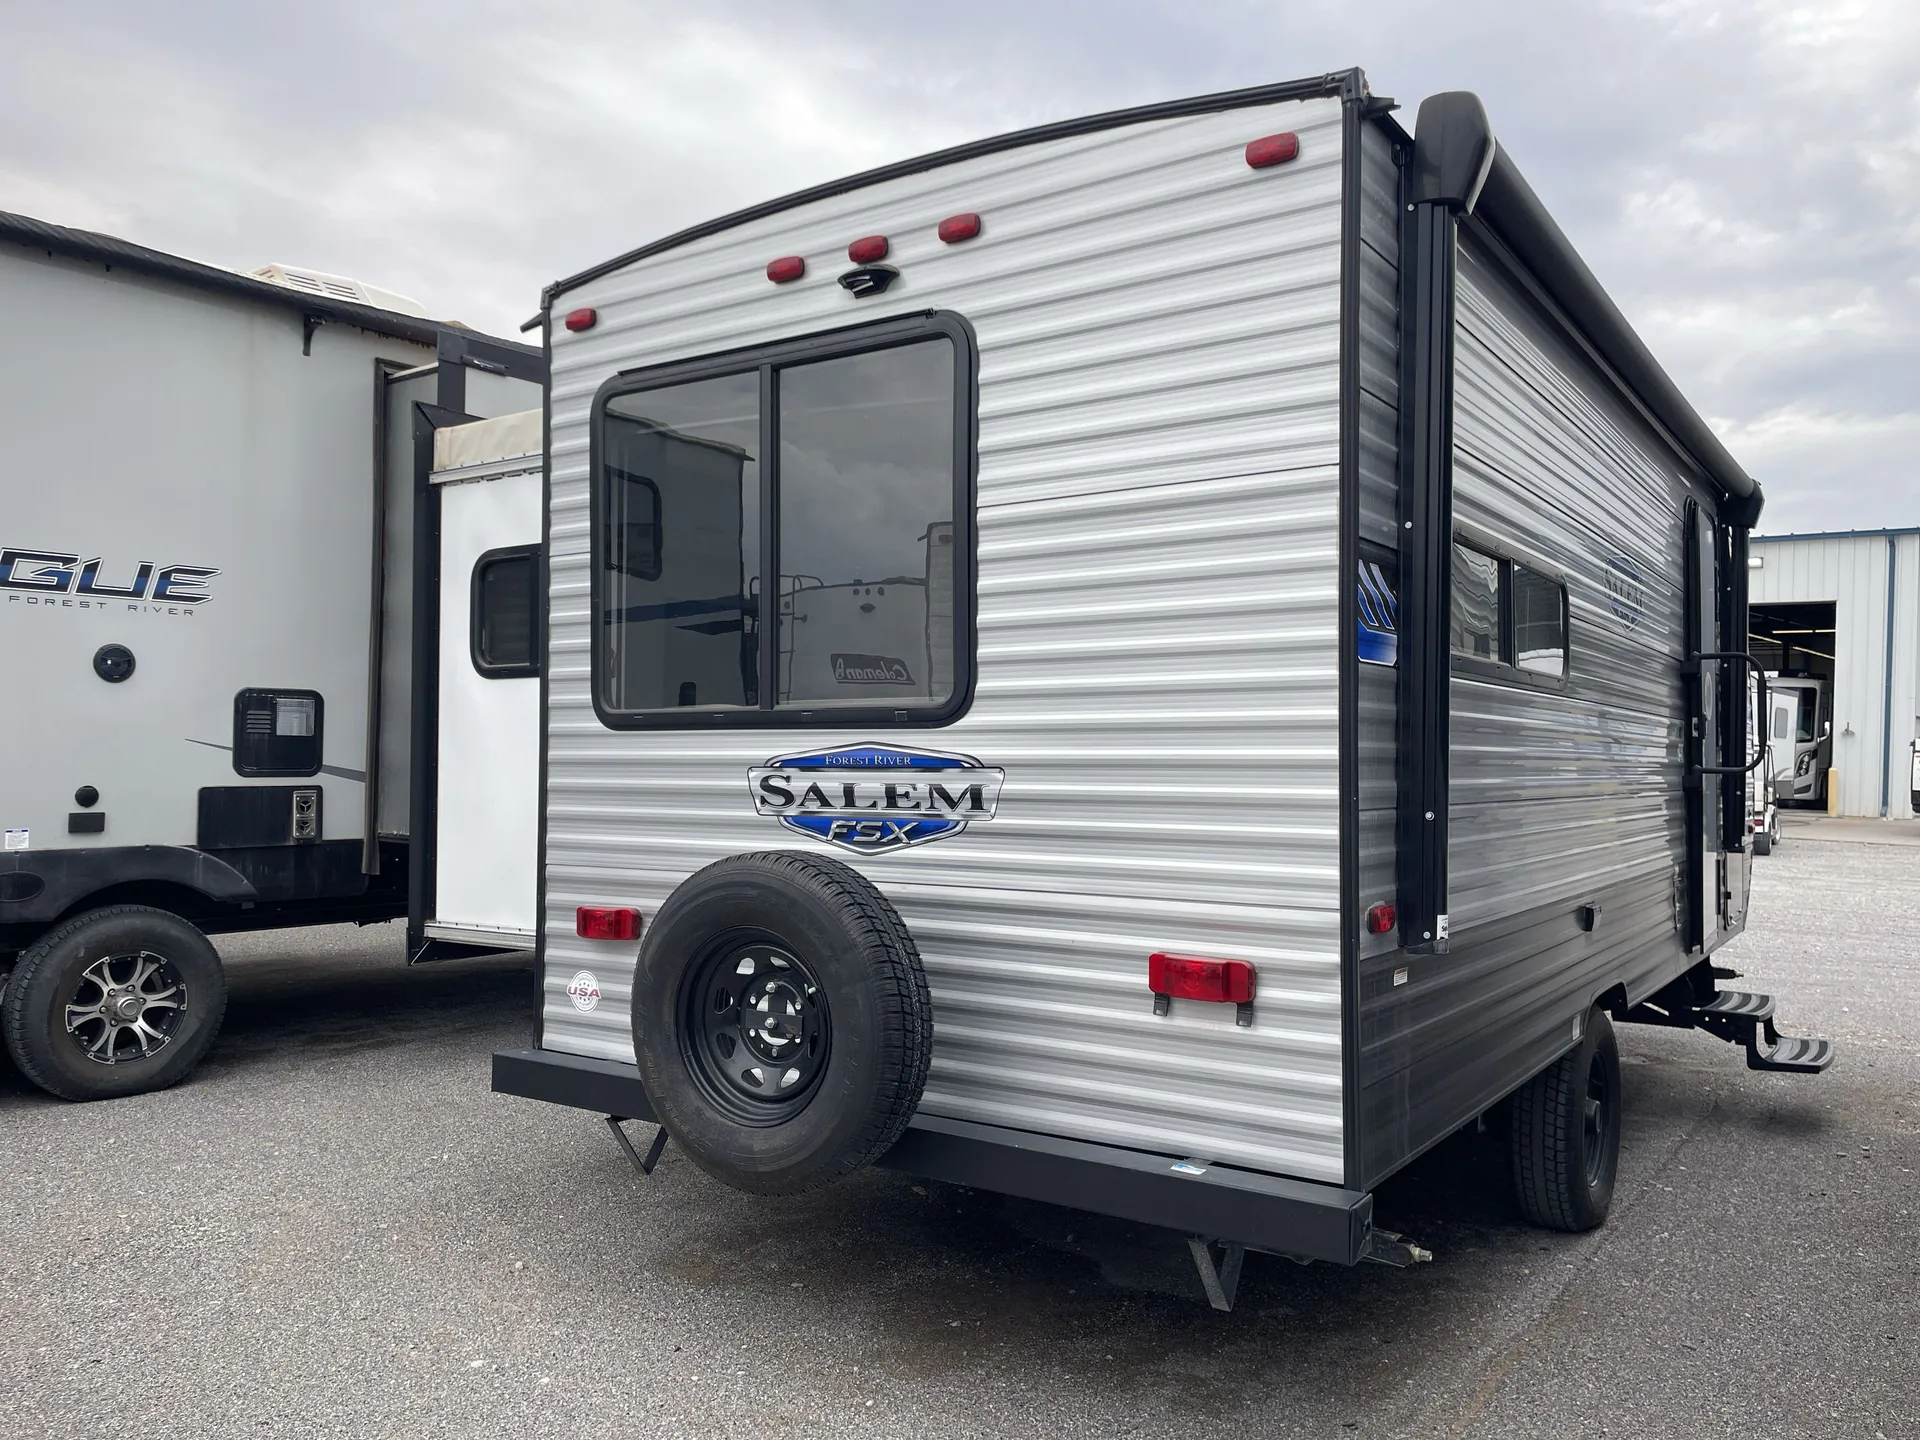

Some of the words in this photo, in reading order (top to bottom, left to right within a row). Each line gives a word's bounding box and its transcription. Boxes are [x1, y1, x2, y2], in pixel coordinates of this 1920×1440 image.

[8, 595, 107, 610] FOREST
[127, 603, 195, 617] RIVER
[825, 755, 871, 766] FOREST
[874, 755, 912, 766] RIVER
[758, 774, 991, 813] SALEM
[825, 820, 920, 845] FSX
[567, 985, 601, 998] USA
